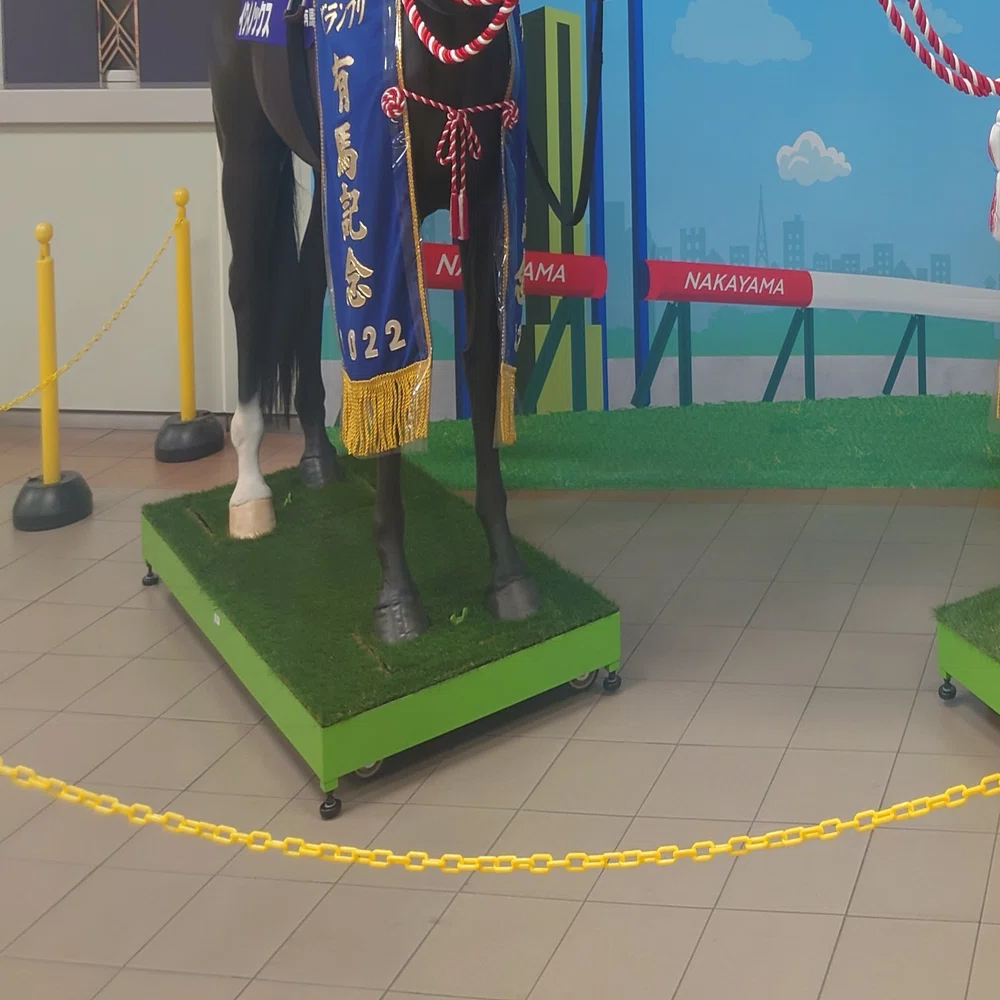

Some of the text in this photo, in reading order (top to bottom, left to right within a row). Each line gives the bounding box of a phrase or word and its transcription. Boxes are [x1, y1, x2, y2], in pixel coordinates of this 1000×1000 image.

[331, 52, 374, 308] 有馬記念
[684, 271, 785, 295] NAKAYAMA
[339, 319, 407, 362] 022
